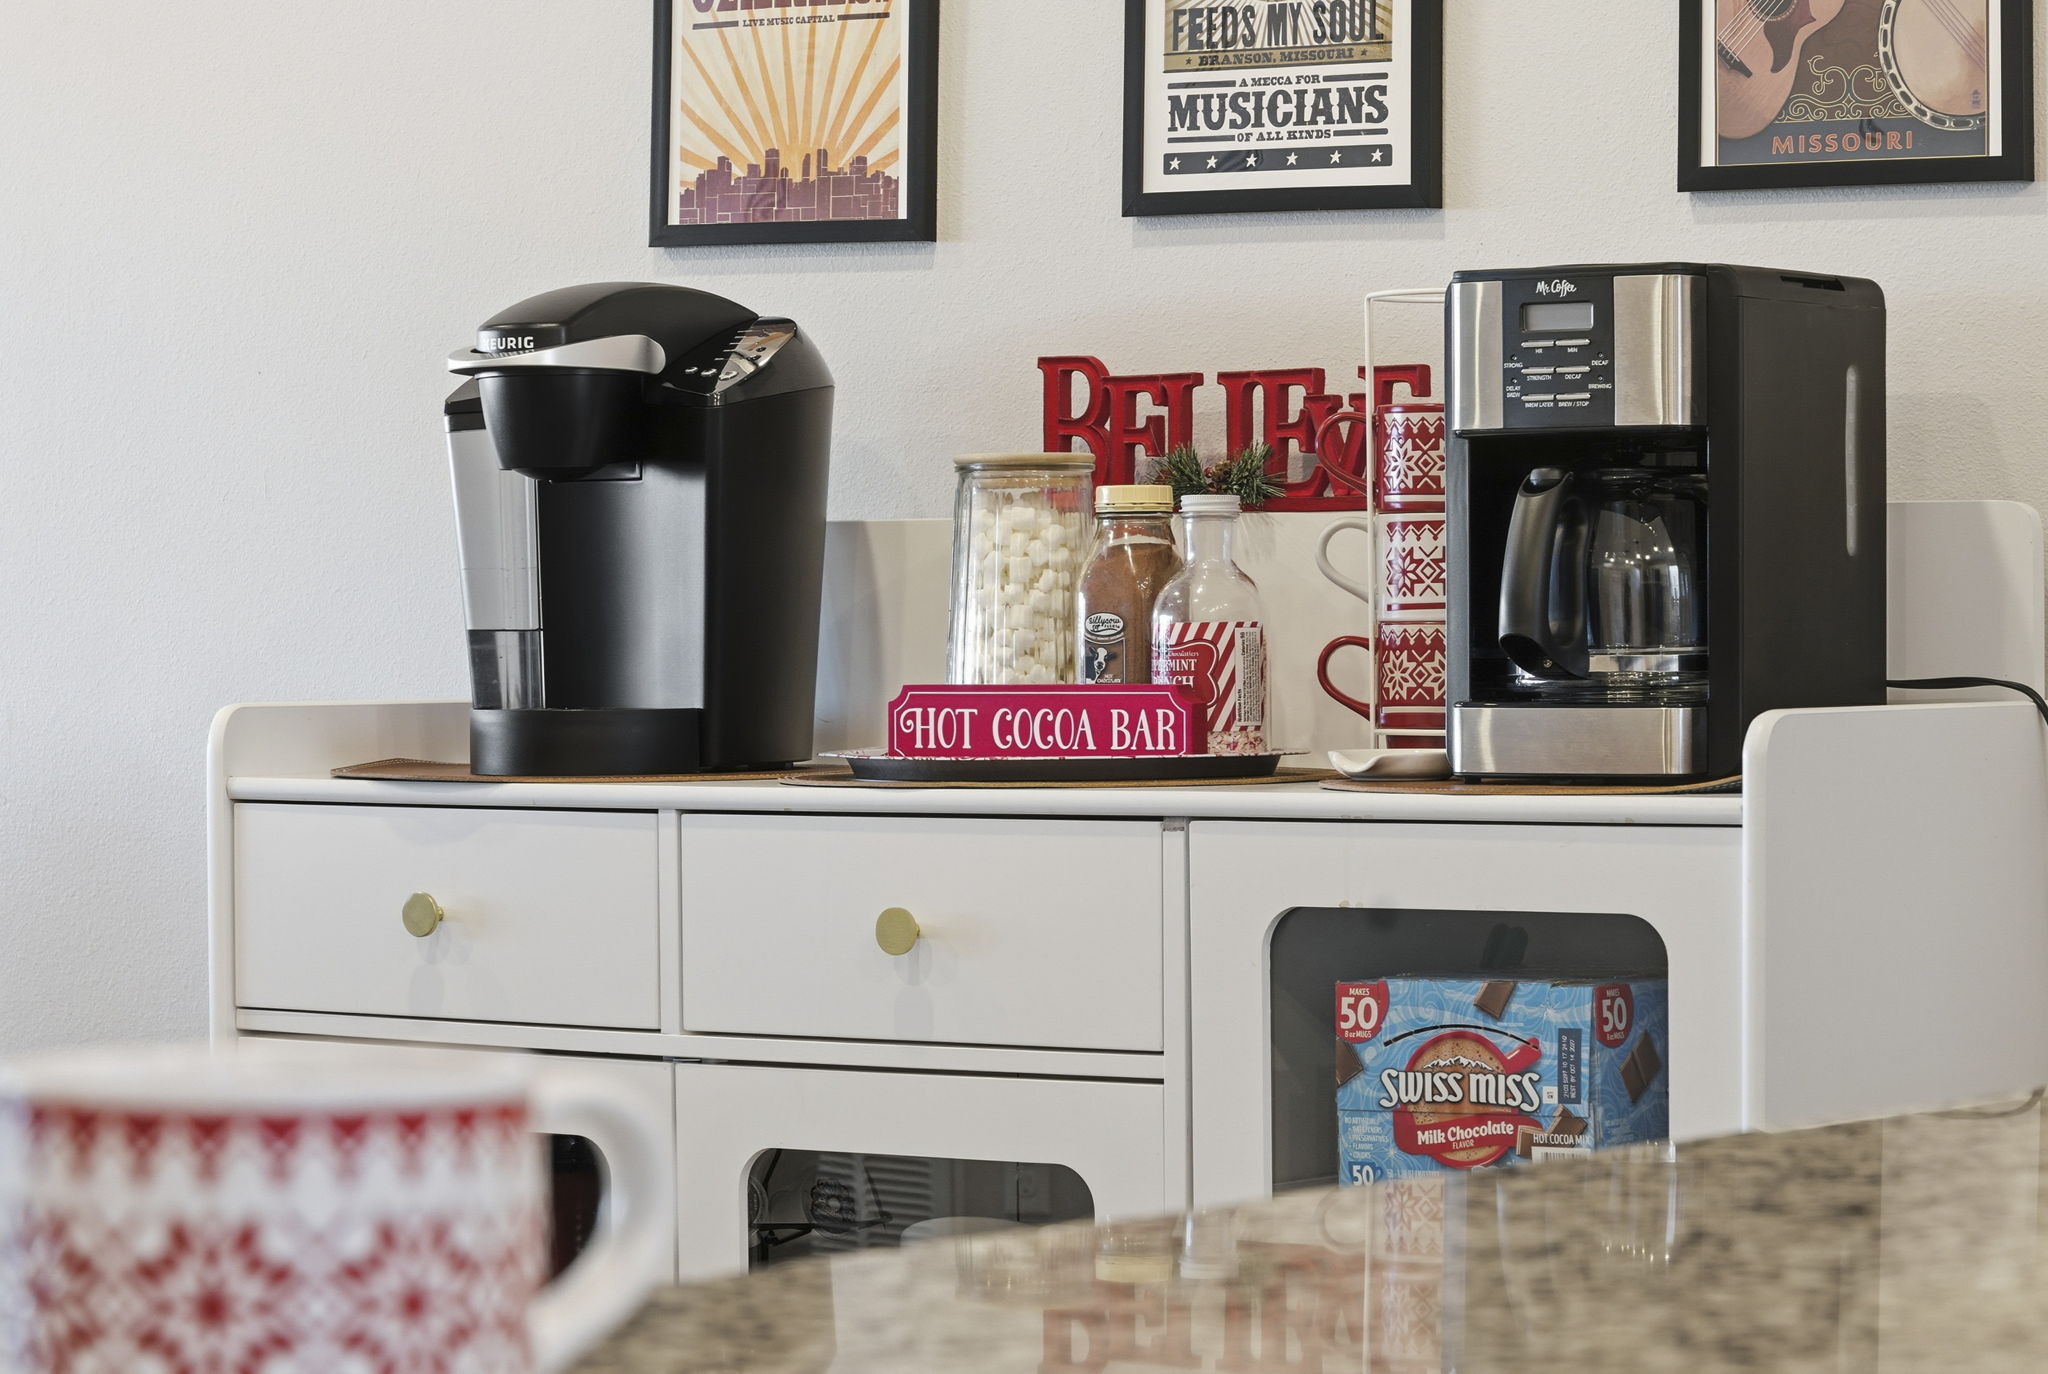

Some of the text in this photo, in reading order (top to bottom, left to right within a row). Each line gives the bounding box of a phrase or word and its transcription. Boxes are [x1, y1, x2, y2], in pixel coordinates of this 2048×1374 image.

[742, 15, 835, 27] LIVE MUSIC CAPITAL
[1173, 0, 1384, 51] FEEDS MY SOUL
[1198, 48, 1354, 66] BRANSON, MISSOURI
[1239, 75, 1321, 87] A MECCA FOR
[1167, 84, 1389, 132] MUSICIANS
[1237, 129, 1332, 142] OF ALL KINDS
[1771, 130, 1913, 155] MISSOURI
[1551, 279, 1577, 298] Coffee
[483, 336, 534, 350] EURIG
[1037, 355, 1431, 512] BELIEV
[900, 707, 1176, 751] HOT COCOA BAR
[1349, 987, 1370, 996] MAKES
[1340, 996, 1378, 1030] 50
[1602, 997, 1627, 1032] 50
[1355, 1030, 1372, 1038] MUGS
[1379, 1068, 1464, 1108] SWISS
[1417, 1120, 1515, 1146] Milk Chocolate
[1533, 1133, 1547, 1144] HOT
[1549, 1133, 1575, 1145] COCOA
[1452, 1139, 1475, 1150] FLAVOR
[1352, 1164, 1374, 1187] 50
